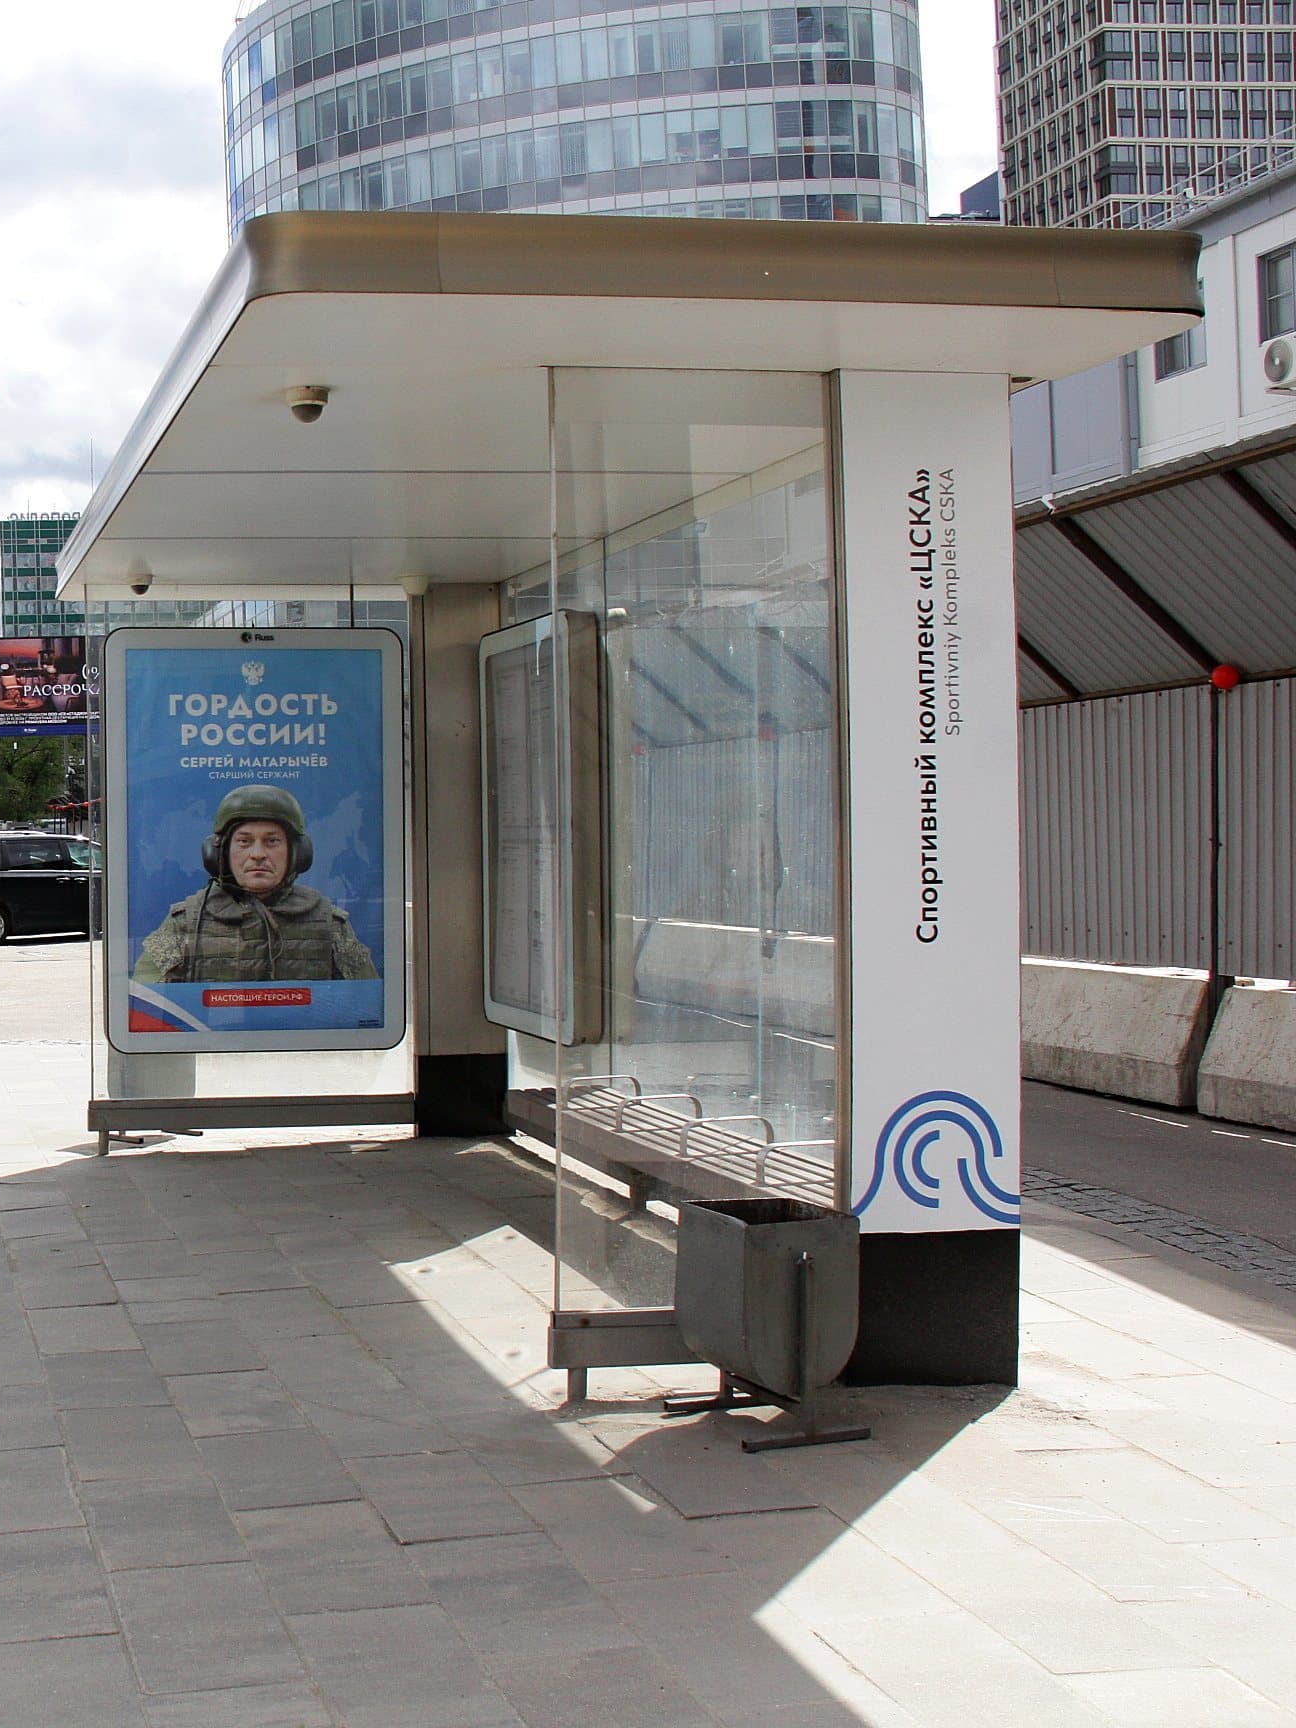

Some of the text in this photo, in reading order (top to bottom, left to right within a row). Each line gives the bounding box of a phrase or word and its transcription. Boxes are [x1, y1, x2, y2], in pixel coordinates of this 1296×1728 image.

[939, 468, 964, 736] Sportivniy Kompleks CSKA
[168, 693, 338, 719] ГОРДОСТЬ
[908, 468, 943, 944] Спортивный комплекс «ЦСКА»
[181, 723, 326, 746] РОССИИ!
[180, 753, 329, 768] СЕРГЕЙ МАГАРЫЧЁВ
[208, 770, 301, 780] СТАРШИЙ СЕРЖАНТ
[211, 993, 304, 1003] НАСТОЯЩИЕ-ГЕРОИ.РФ
